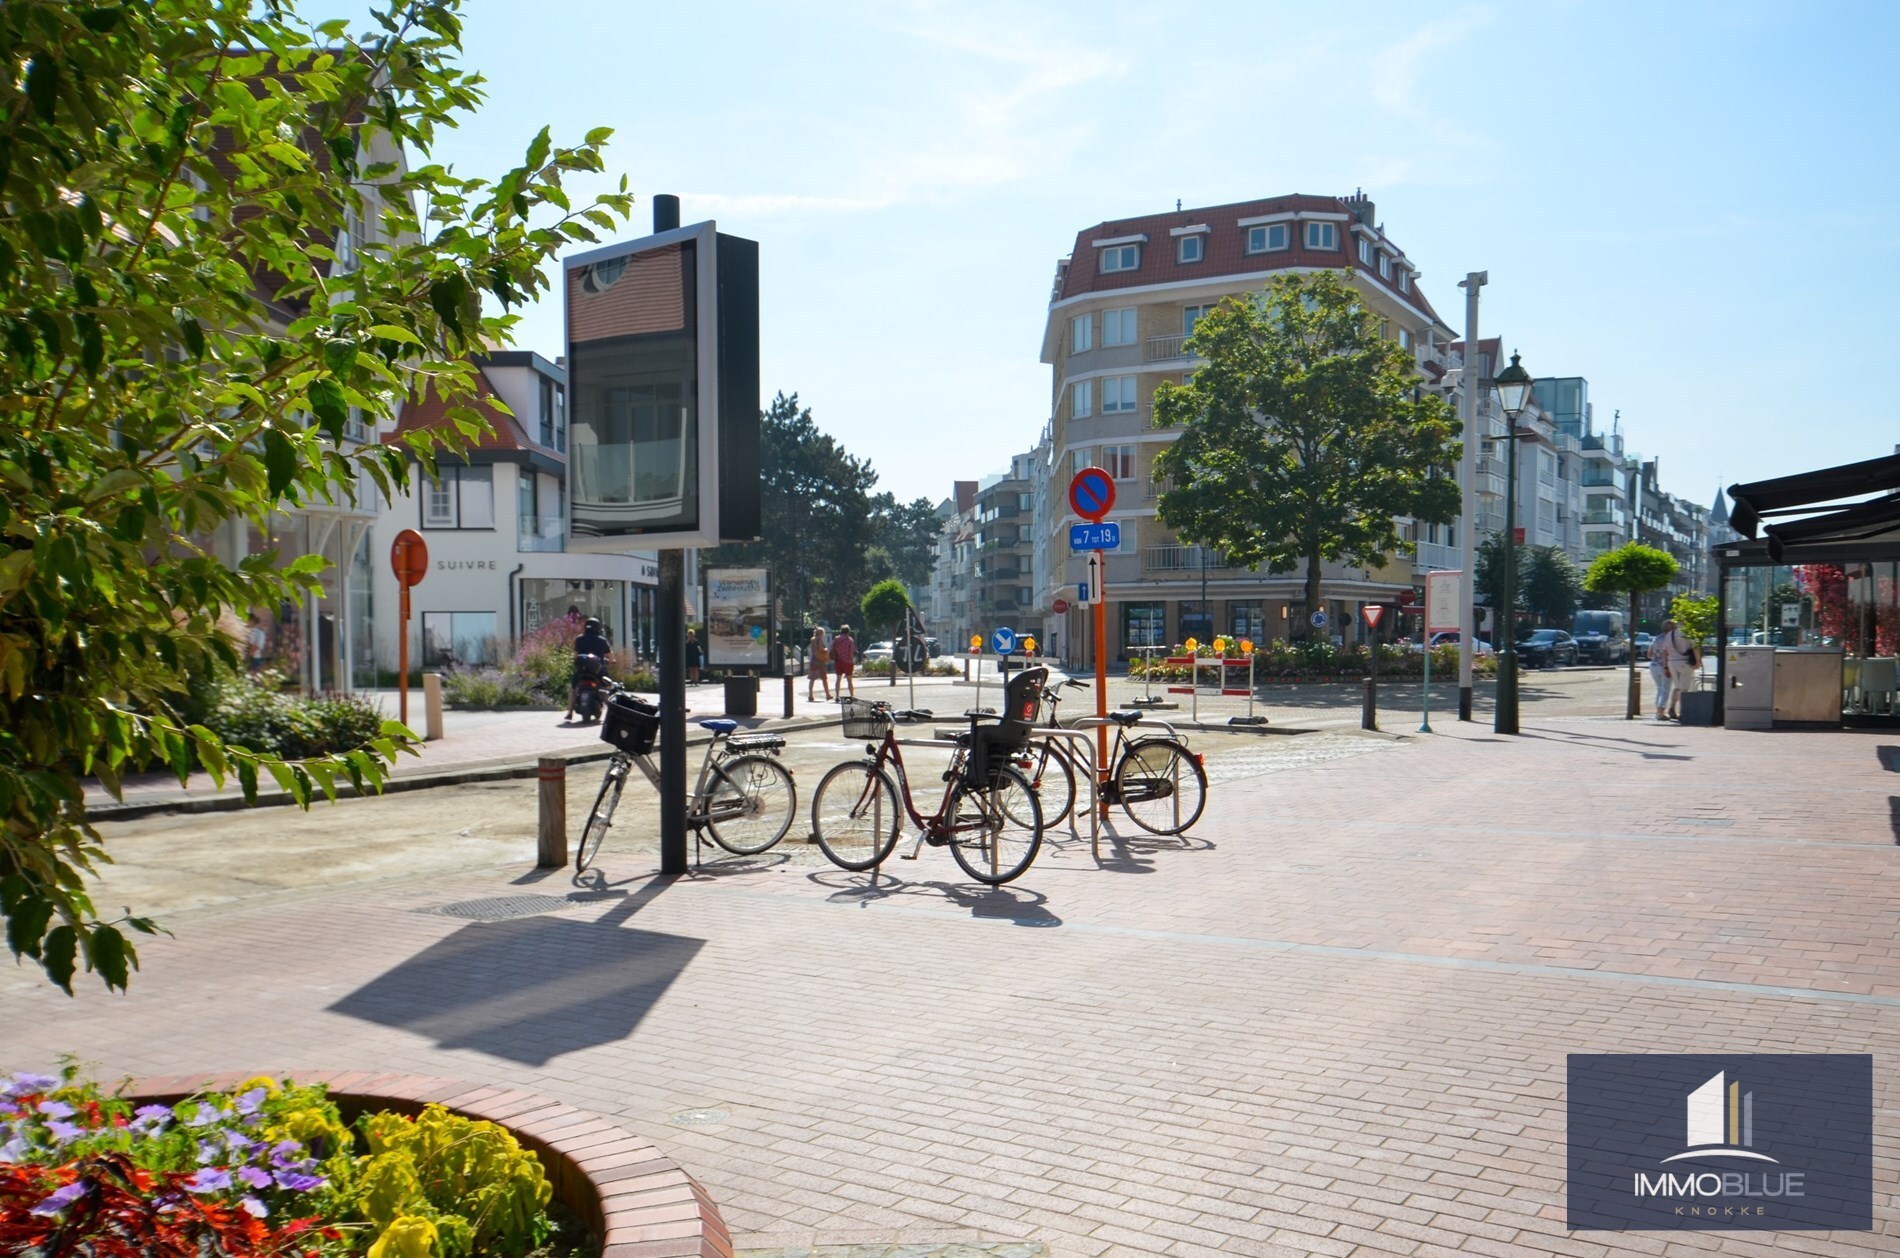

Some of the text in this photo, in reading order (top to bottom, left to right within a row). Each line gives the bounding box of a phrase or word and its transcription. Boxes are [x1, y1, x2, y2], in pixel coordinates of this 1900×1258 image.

[1083, 530, 1089, 544] 7
[1100, 529, 1111, 543] 19
[437, 560, 497, 570] SUIVRE
